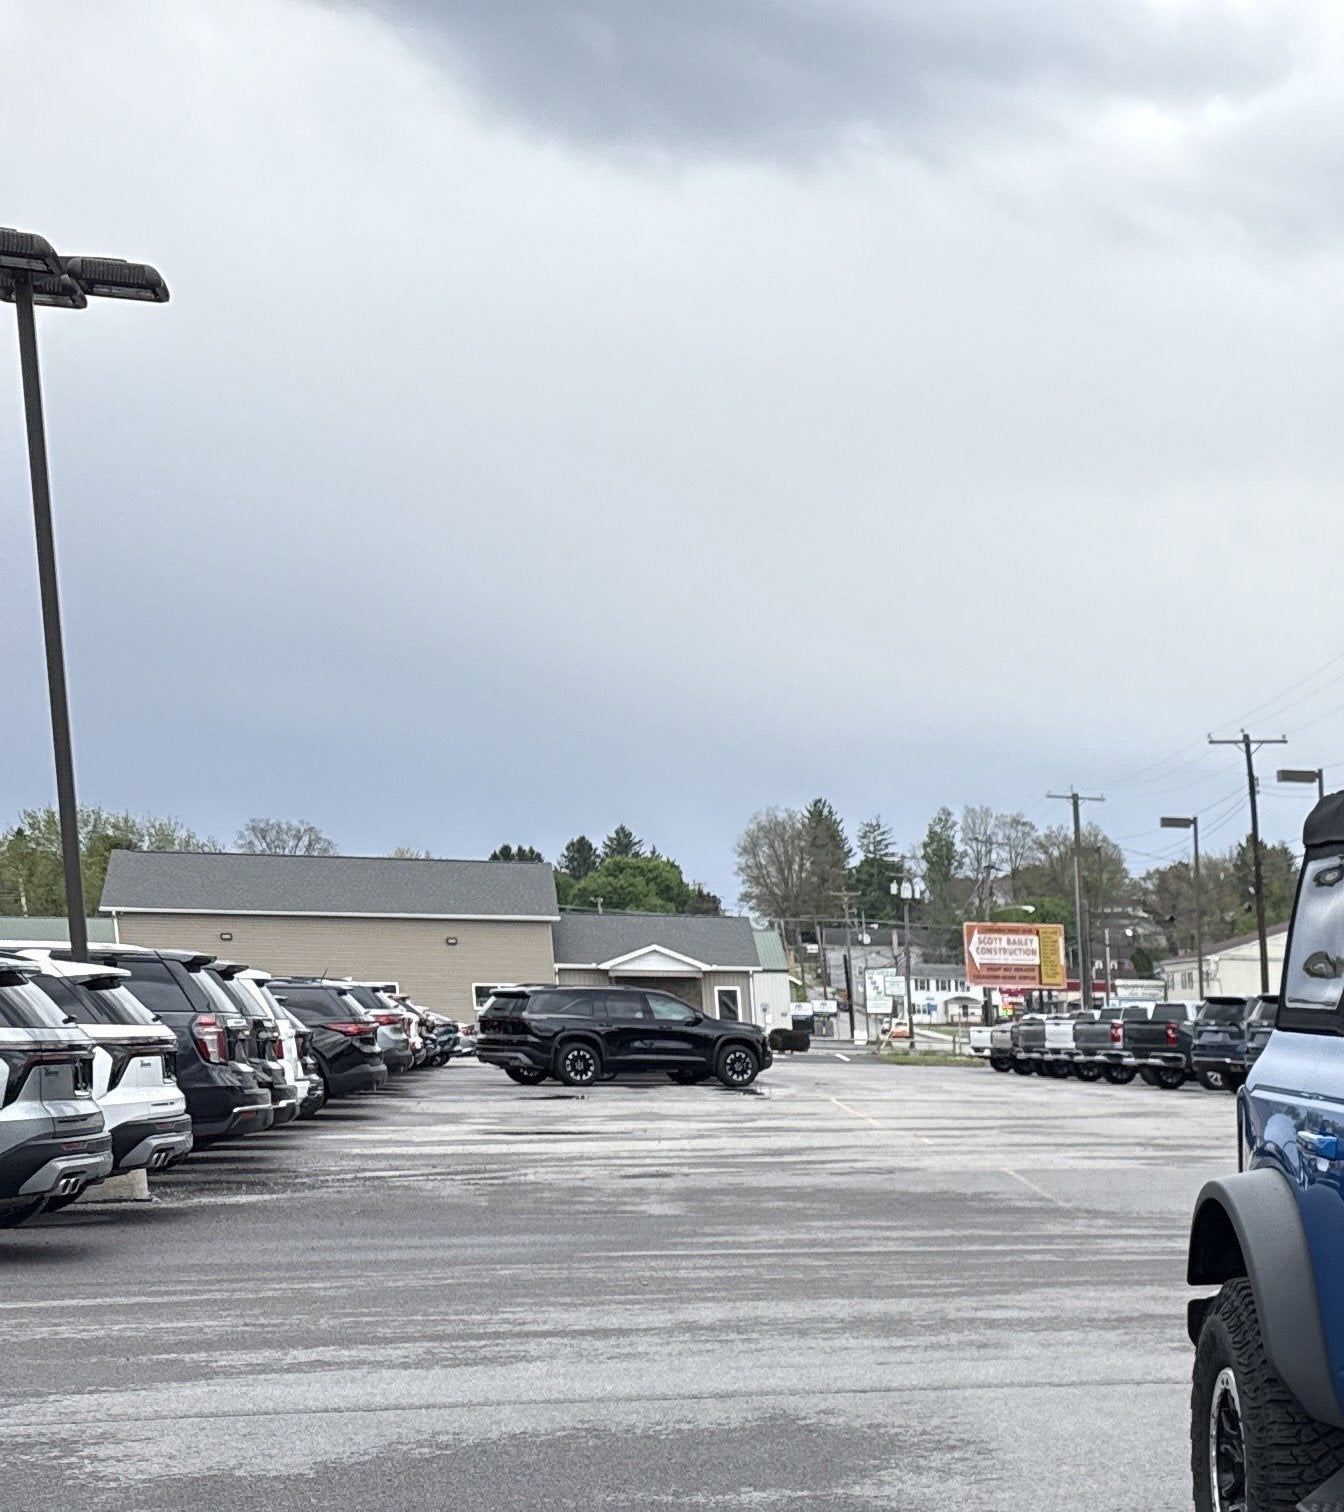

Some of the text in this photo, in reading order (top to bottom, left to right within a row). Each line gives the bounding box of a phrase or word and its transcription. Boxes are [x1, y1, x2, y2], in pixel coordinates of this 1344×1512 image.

[977, 937, 1034, 947] SCOTT BAILEY
[975, 947, 1037, 956] CONSTRUCTION
